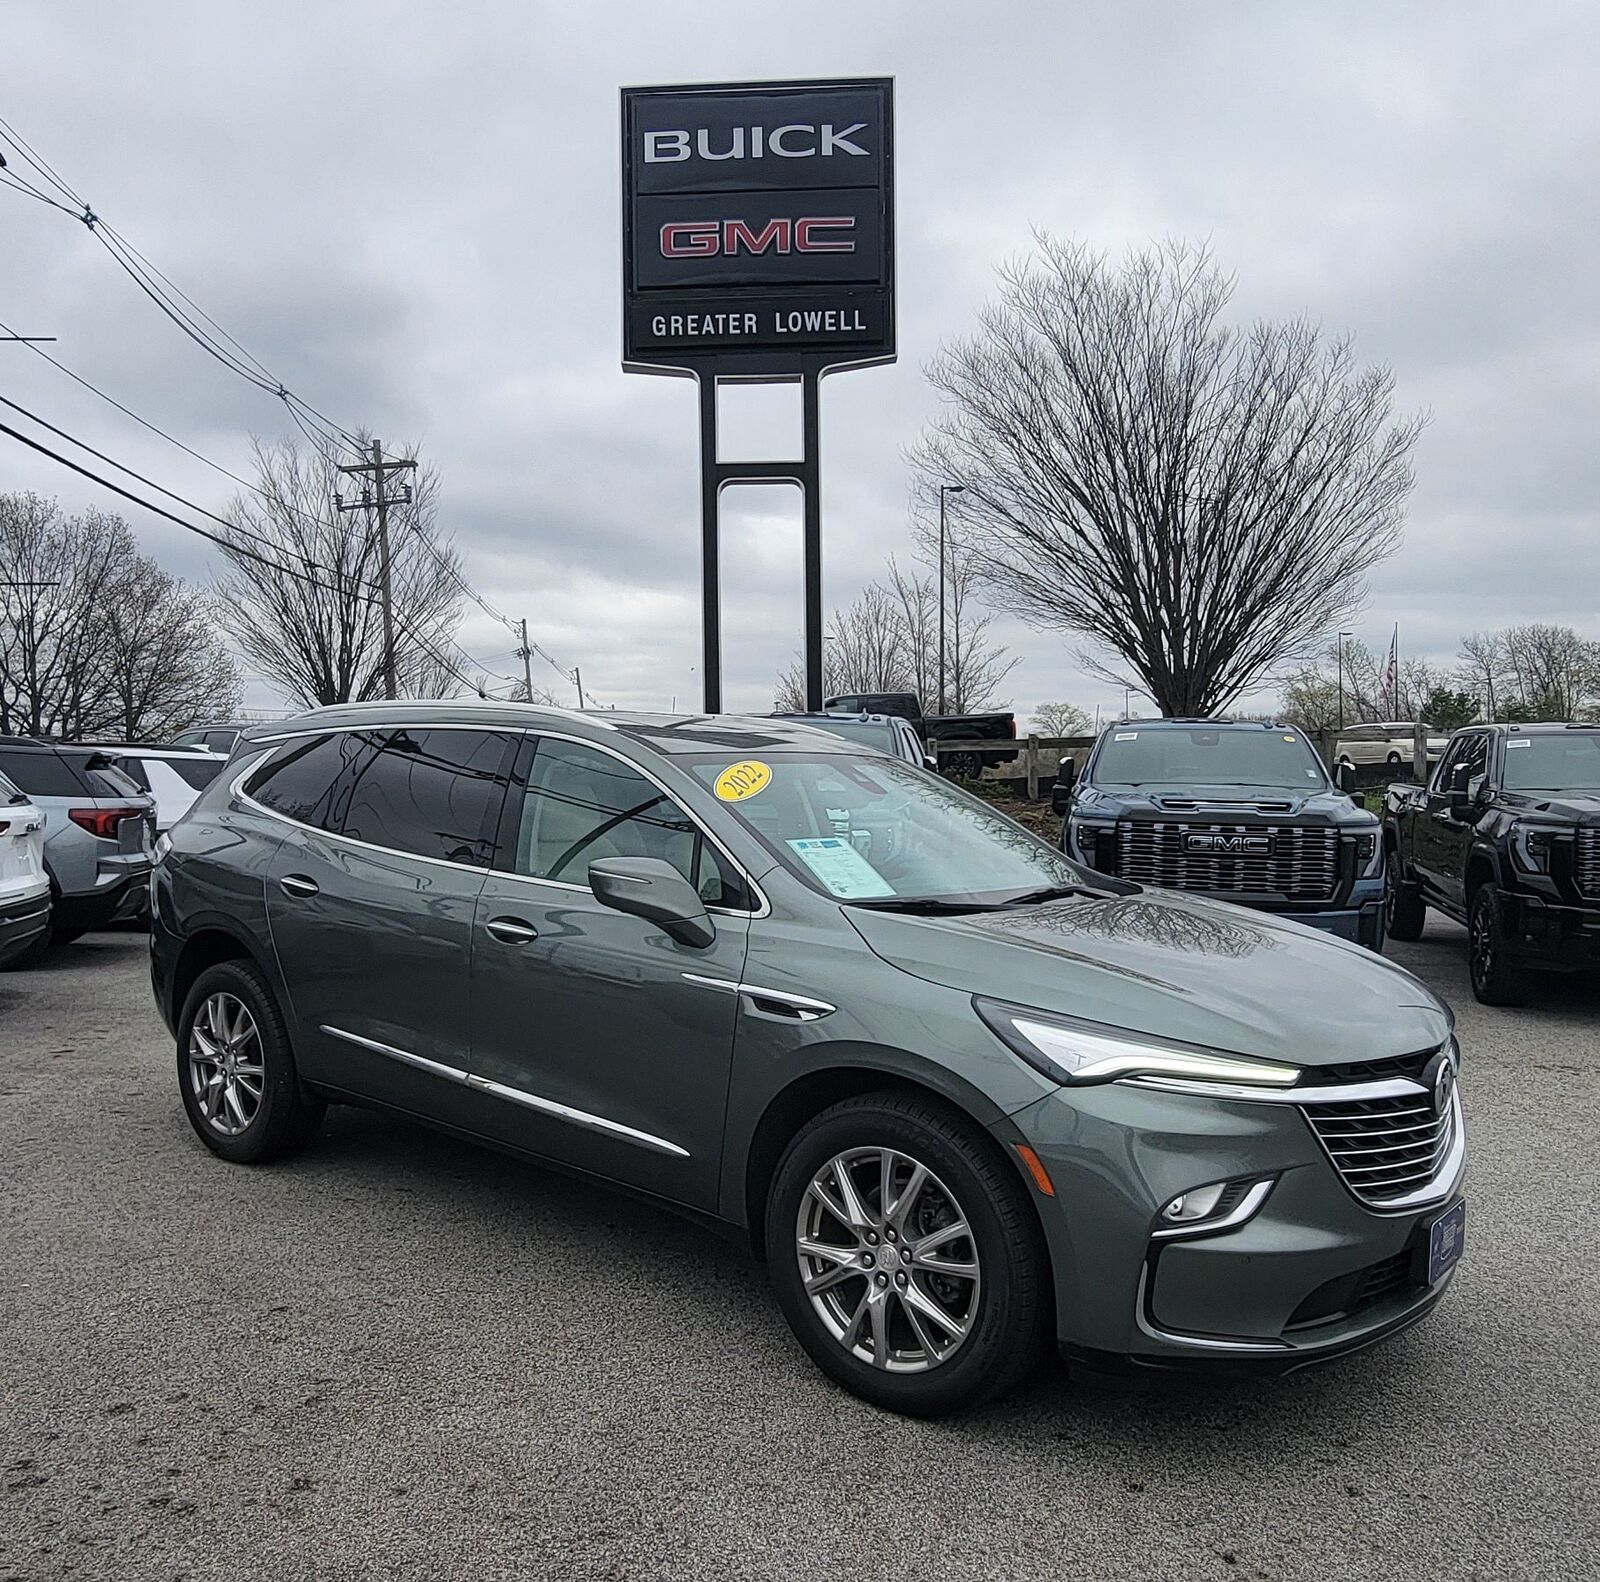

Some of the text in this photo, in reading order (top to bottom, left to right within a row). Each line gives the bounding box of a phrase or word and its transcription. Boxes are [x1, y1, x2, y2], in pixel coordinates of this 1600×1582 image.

[643, 123, 870, 163] BUICK
[660, 217, 855, 257] GMC
[652, 310, 866, 336] GREATER LOWELL
[723, 765, 763, 796] 2022
[1188, 835, 1269, 852] GMC
